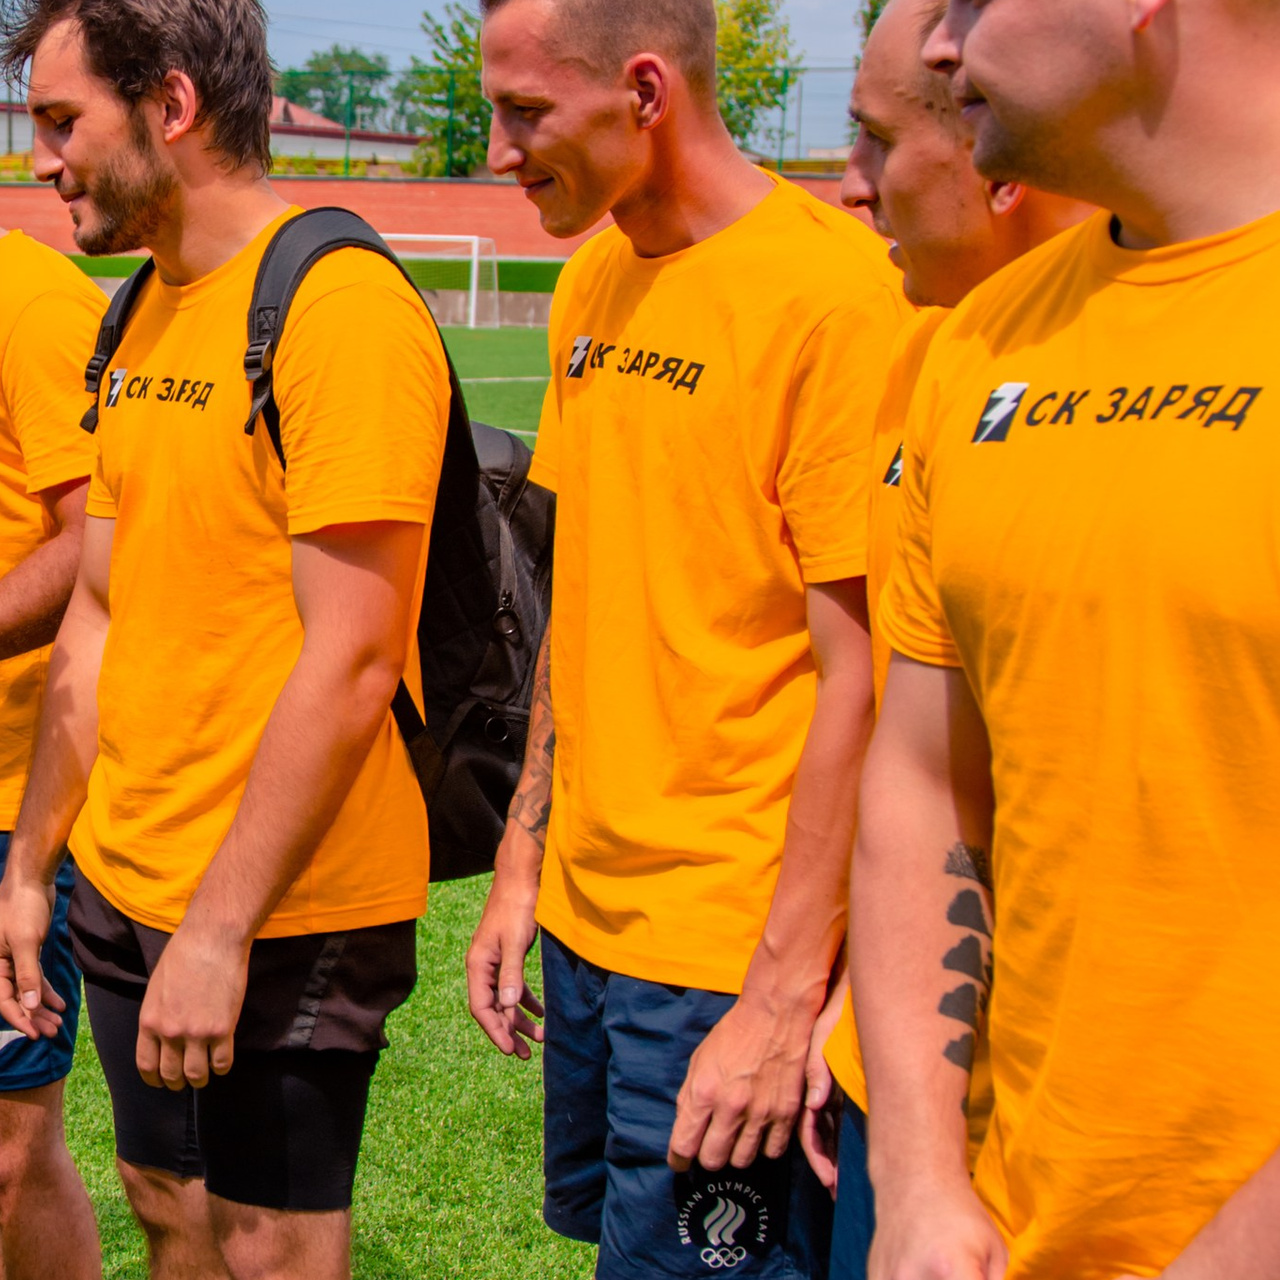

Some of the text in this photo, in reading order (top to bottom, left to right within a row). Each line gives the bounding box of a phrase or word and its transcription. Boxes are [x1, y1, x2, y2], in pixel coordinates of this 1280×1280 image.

[617, 347, 706, 395] ЗАРЯД
[1025, 384, 1264, 432] СК ЗАРЯД
[677, 1181, 769, 1246] RUSSIAN OLYMPIC TEAM
